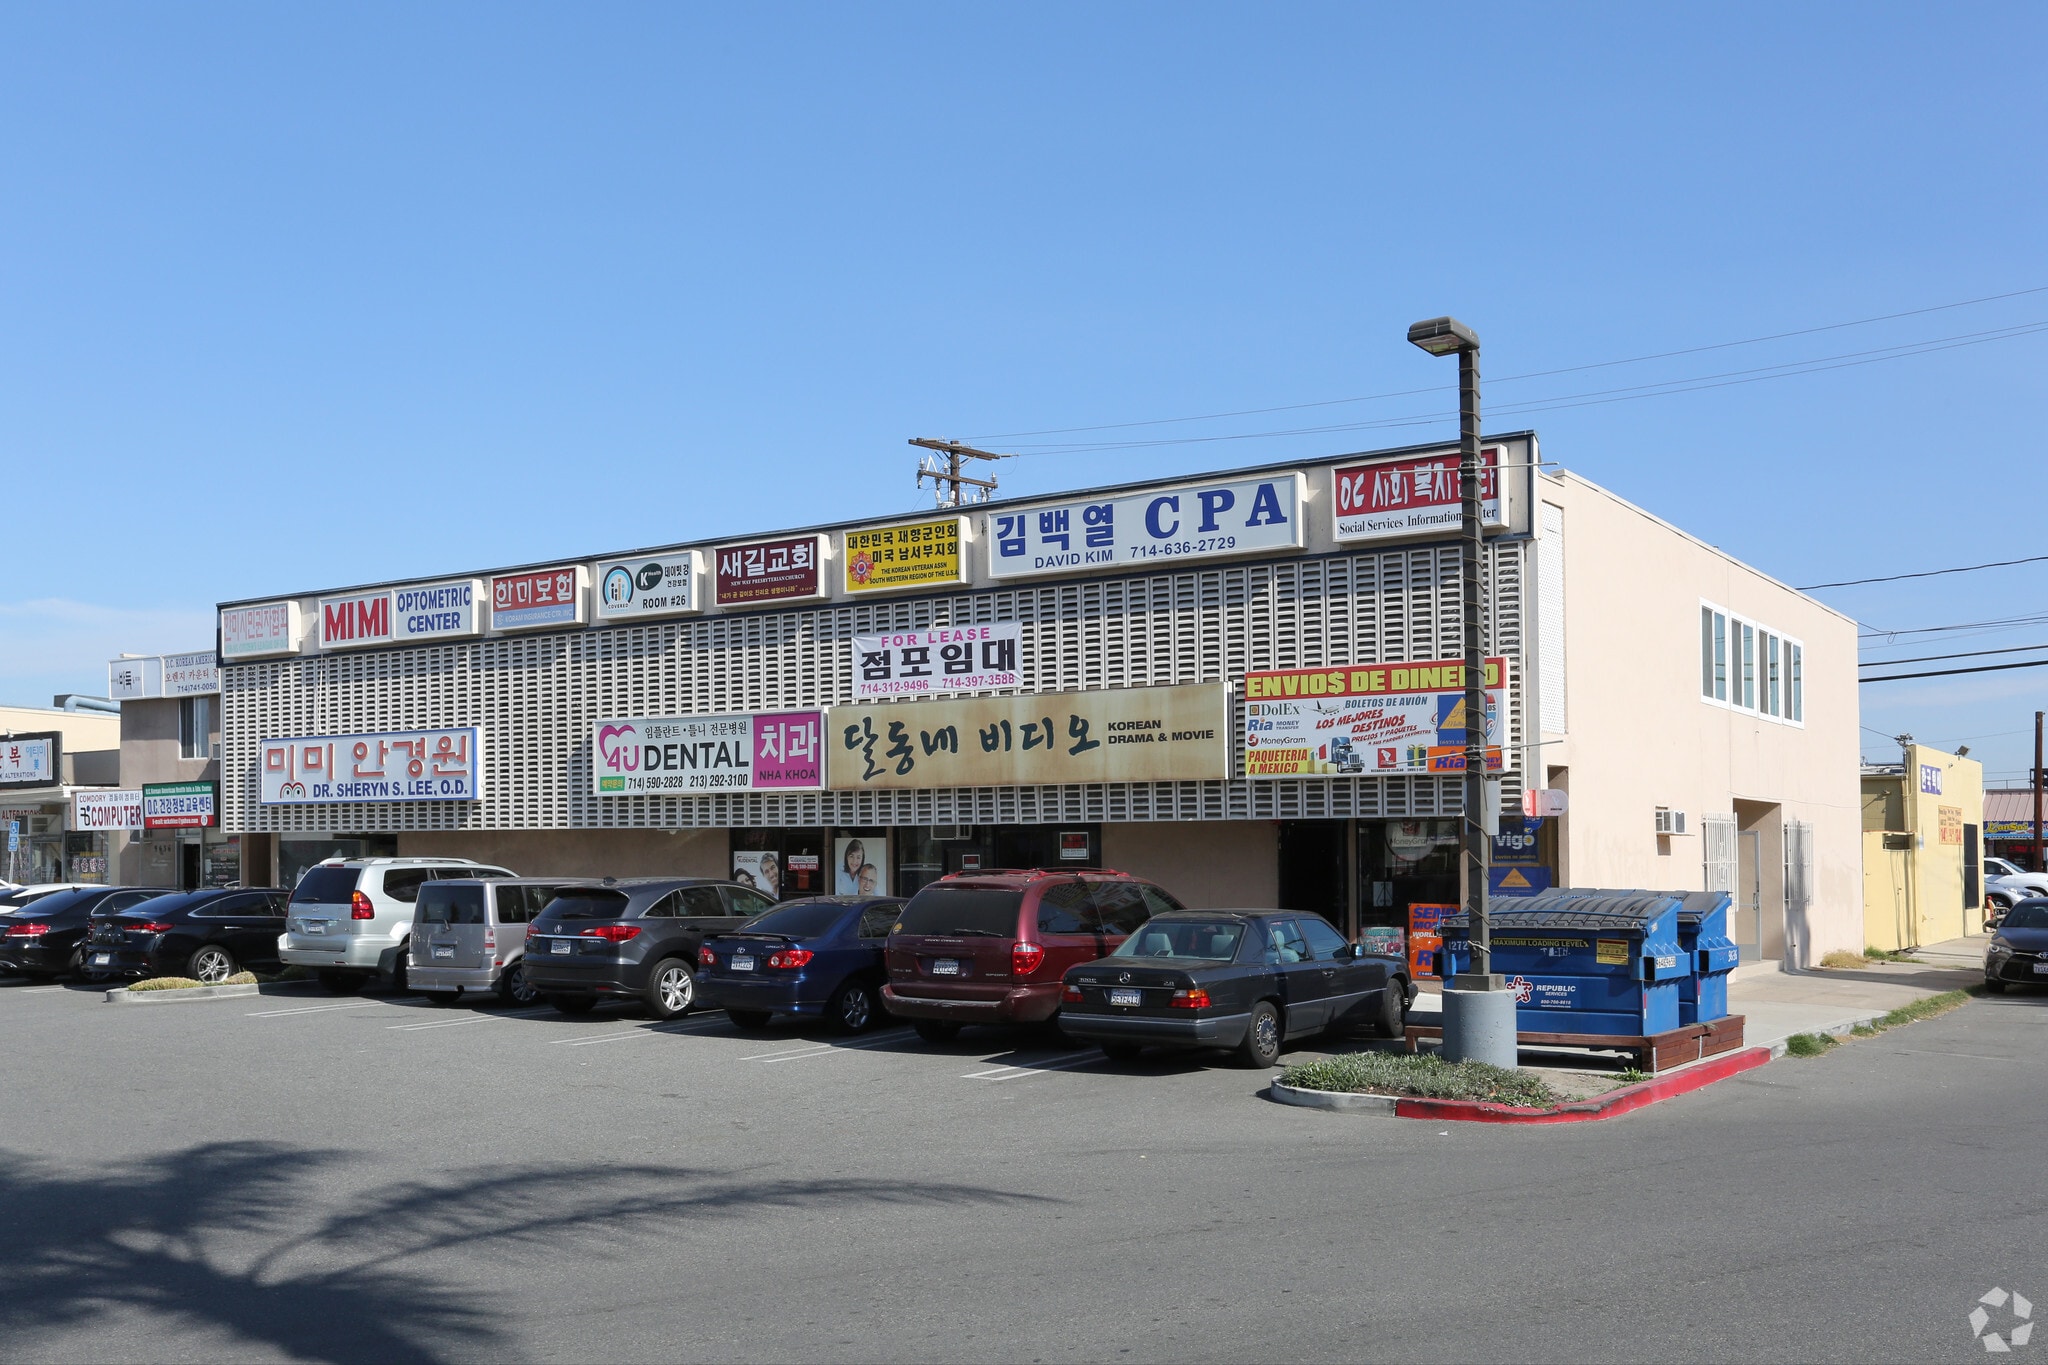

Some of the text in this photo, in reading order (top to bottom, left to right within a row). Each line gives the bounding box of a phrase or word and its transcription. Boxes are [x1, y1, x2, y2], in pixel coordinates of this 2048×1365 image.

[997, 483, 1288, 558] 김백열 CPA
[1339, 511, 1462, 534] Social Services Information
[848, 524, 957, 549] 대한민국 재향군인회
[720, 542, 814, 578] 새길교회
[872, 541, 957, 563] 미국 남서부지회
[1034, 536, 1236, 569] DAVID KIM 714-636-2729
[891, 566, 910, 574] KOREAN
[911, 563, 934, 572] VETERAN
[934, 561, 947, 569] ASSN
[640, 572, 648, 586] K
[752, 575, 785, 585] PRESBYTERIAN
[785, 573, 805, 581] CHURCH
[869, 577, 885, 585] SOUTH
[886, 575, 908, 583] WESTERN
[909, 573, 927, 581] REGION
[495, 571, 573, 608] 한미보험
[397, 586, 471, 612] OPTOMETRIC
[642, 595, 686, 609] ROOM #26
[325, 597, 389, 642] MIMI
[407, 611, 460, 633] CENTER
[524, 611, 551, 620] INSURANCE
[881, 627, 990, 648] FOR LEASE
[175, 657, 194, 668] KOREAN
[165, 670, 185, 682] 오렌지
[189, 668, 208, 680] 카운티
[177, 683, 217, 693] 714)741-0050
[860, 673, 1015, 695] 714-312-9496 714-397-3588
[1247, 671, 1346, 698] ENVIO$
[1350, 670, 1386, 692] DE
[1261, 703, 1300, 716] DolEx
[1345, 695, 1428, 709] BOLETOS DE AVIÓN
[1107, 720, 1162, 732] KOREAN
[1247, 717, 1273, 731] Ria
[1316, 709, 1384, 730] LOS MEJORES
[1351, 714, 1406, 734] DESTINOS
[710, 721, 747, 736] 전문병원
[979, 714, 1100, 757] 비디오
[1107, 729, 1215, 745] DRAMA & MOVIE
[1351, 733, 1378, 743] PRECIOS
[1385, 725, 1418, 737] PAQUETES
[759, 721, 818, 764] 치과
[1260, 737, 1306, 746] MoneyGram
[267, 736, 468, 781] 미미 안경원
[644, 741, 749, 771] DENTAL
[1248, 749, 1307, 763] PAQUETERIA
[1435, 750, 1466, 769] Ria
[5, 771, 36, 779] ALTERATIONS
[759, 769, 816, 781] NHA KHOA
[1249, 762, 1299, 774] A MEXICO
[313, 779, 468, 797] DR. SHERYN S. LEE, O.D.
[628, 773, 748, 790] 714) 590-2828 213) 292-3100
[79, 794, 106, 803] COMDORY
[91, 805, 142, 826] COMPUTER
[1495, 831, 1535, 850] vigo
[1413, 906, 1458, 919] SEND
[1493, 939, 1527, 947] MAXIMUM
[1561, 940, 1585, 948] LEVEL
